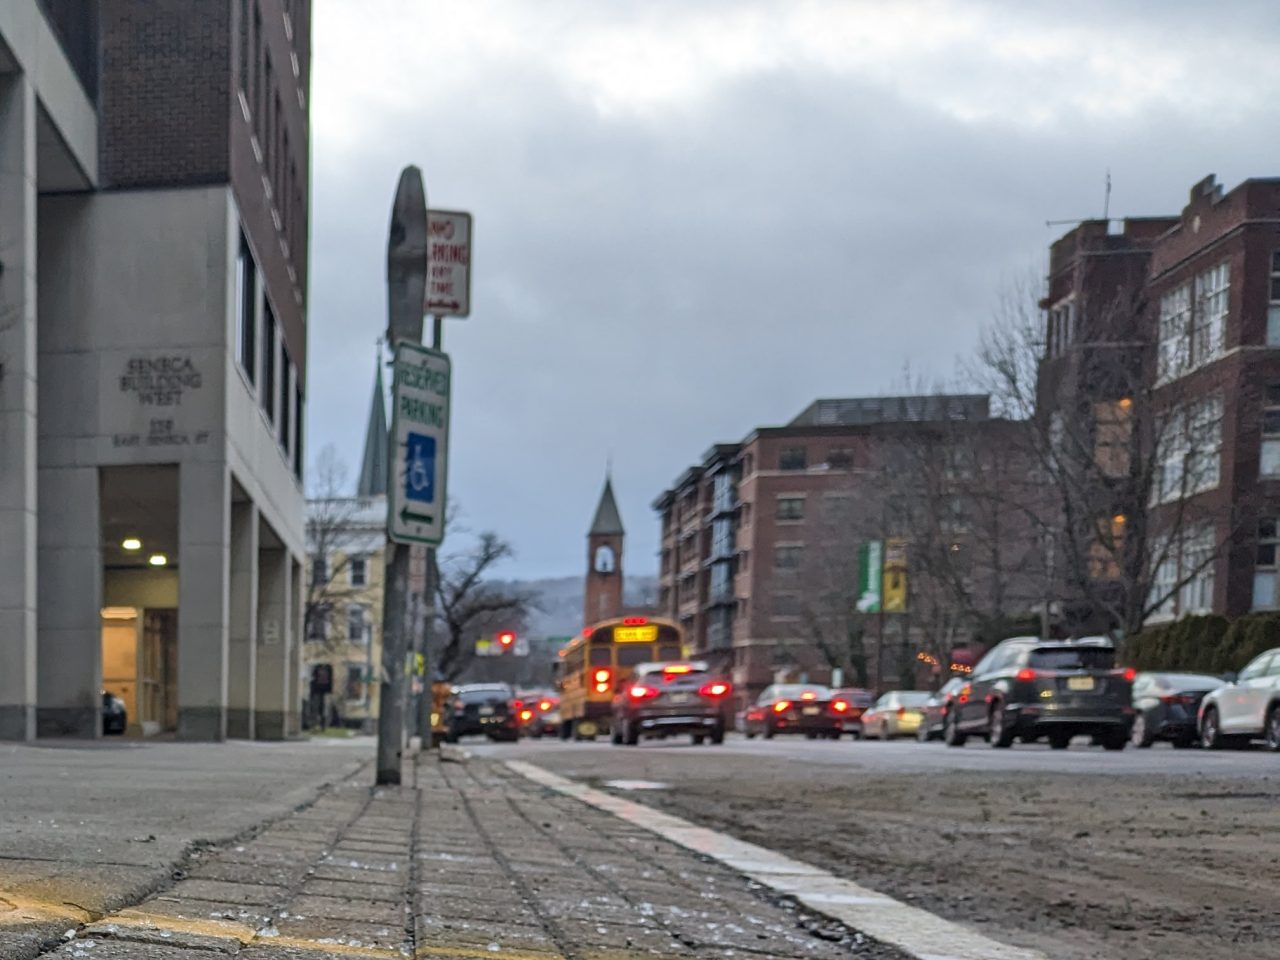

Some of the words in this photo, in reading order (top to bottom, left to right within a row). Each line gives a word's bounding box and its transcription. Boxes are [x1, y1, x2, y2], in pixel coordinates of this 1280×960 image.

[126, 357, 195, 374] SENECA
[119, 372, 203, 391] BUILDING
[399, 361, 447, 397] RESERVED
[138, 390, 183, 407] WEST
[400, 395, 444, 429] PARKING
